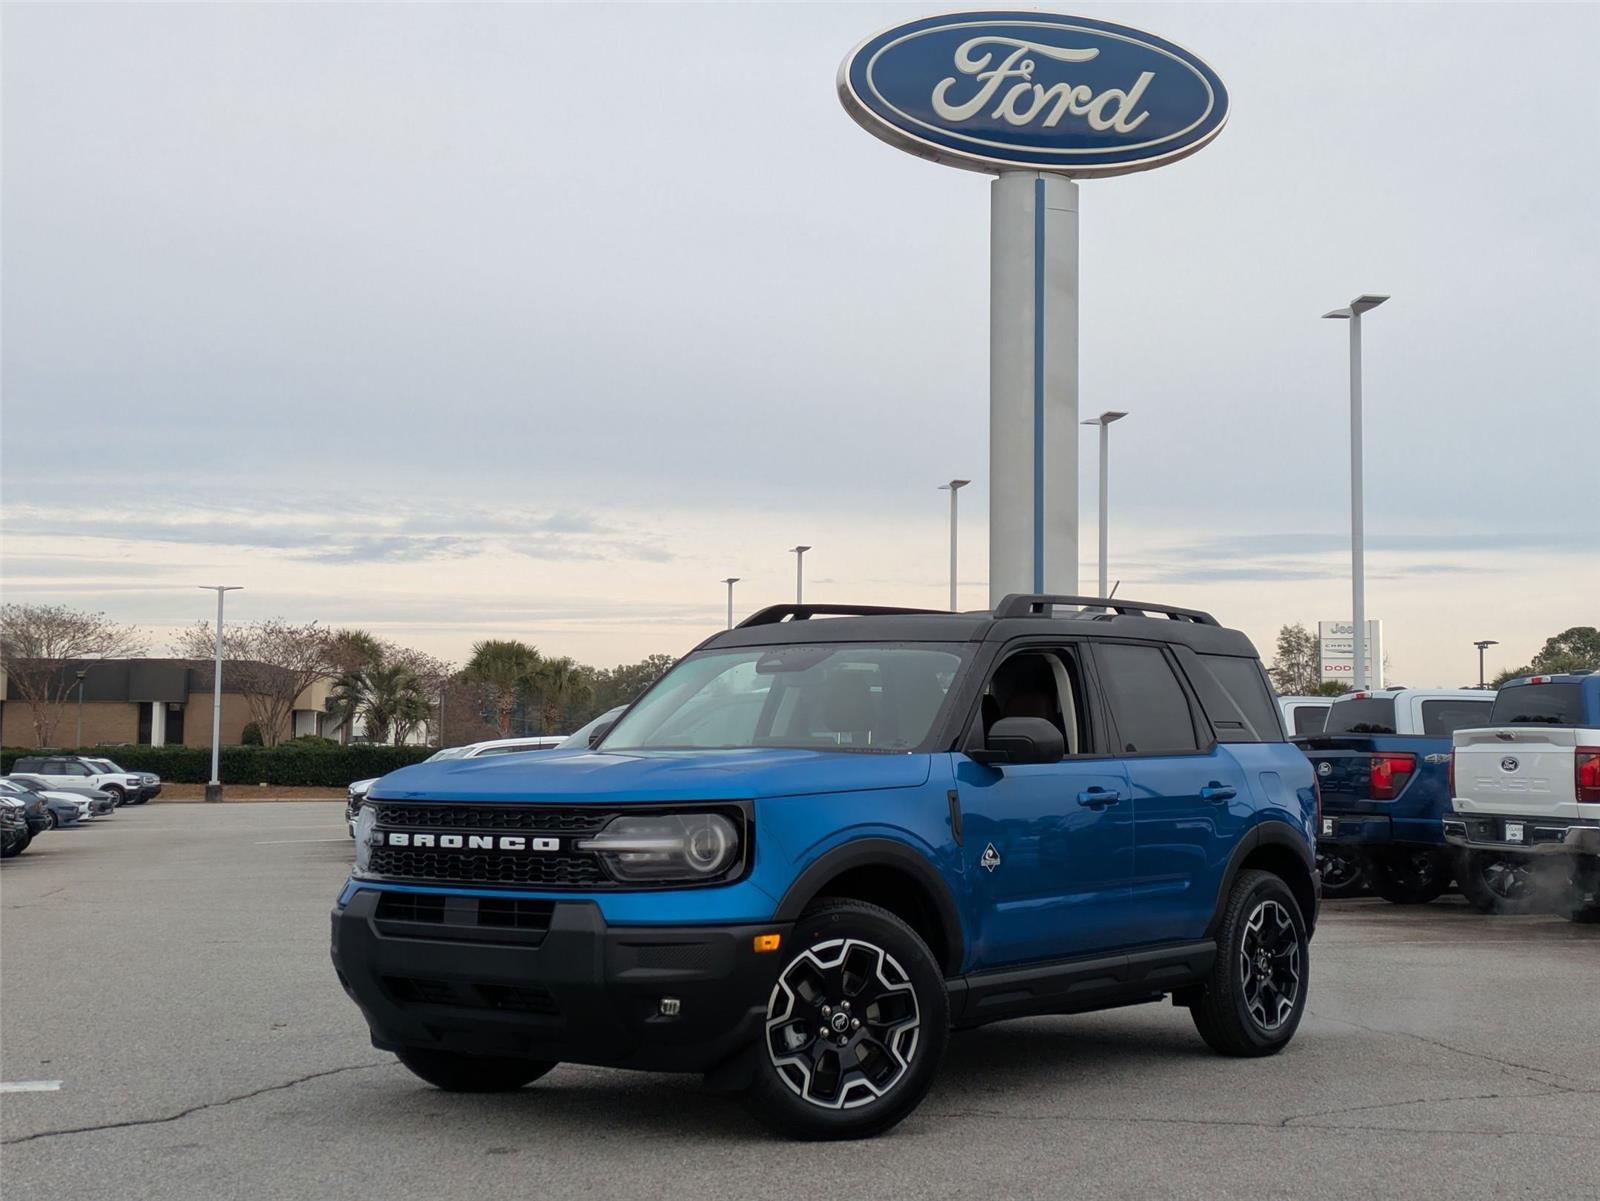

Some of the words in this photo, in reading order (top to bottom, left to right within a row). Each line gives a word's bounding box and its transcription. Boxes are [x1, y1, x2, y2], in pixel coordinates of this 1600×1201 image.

[931, 36, 1156, 134] Ford
[1331, 623, 1356, 634] Jee
[388, 833, 560, 851] BRONCO
